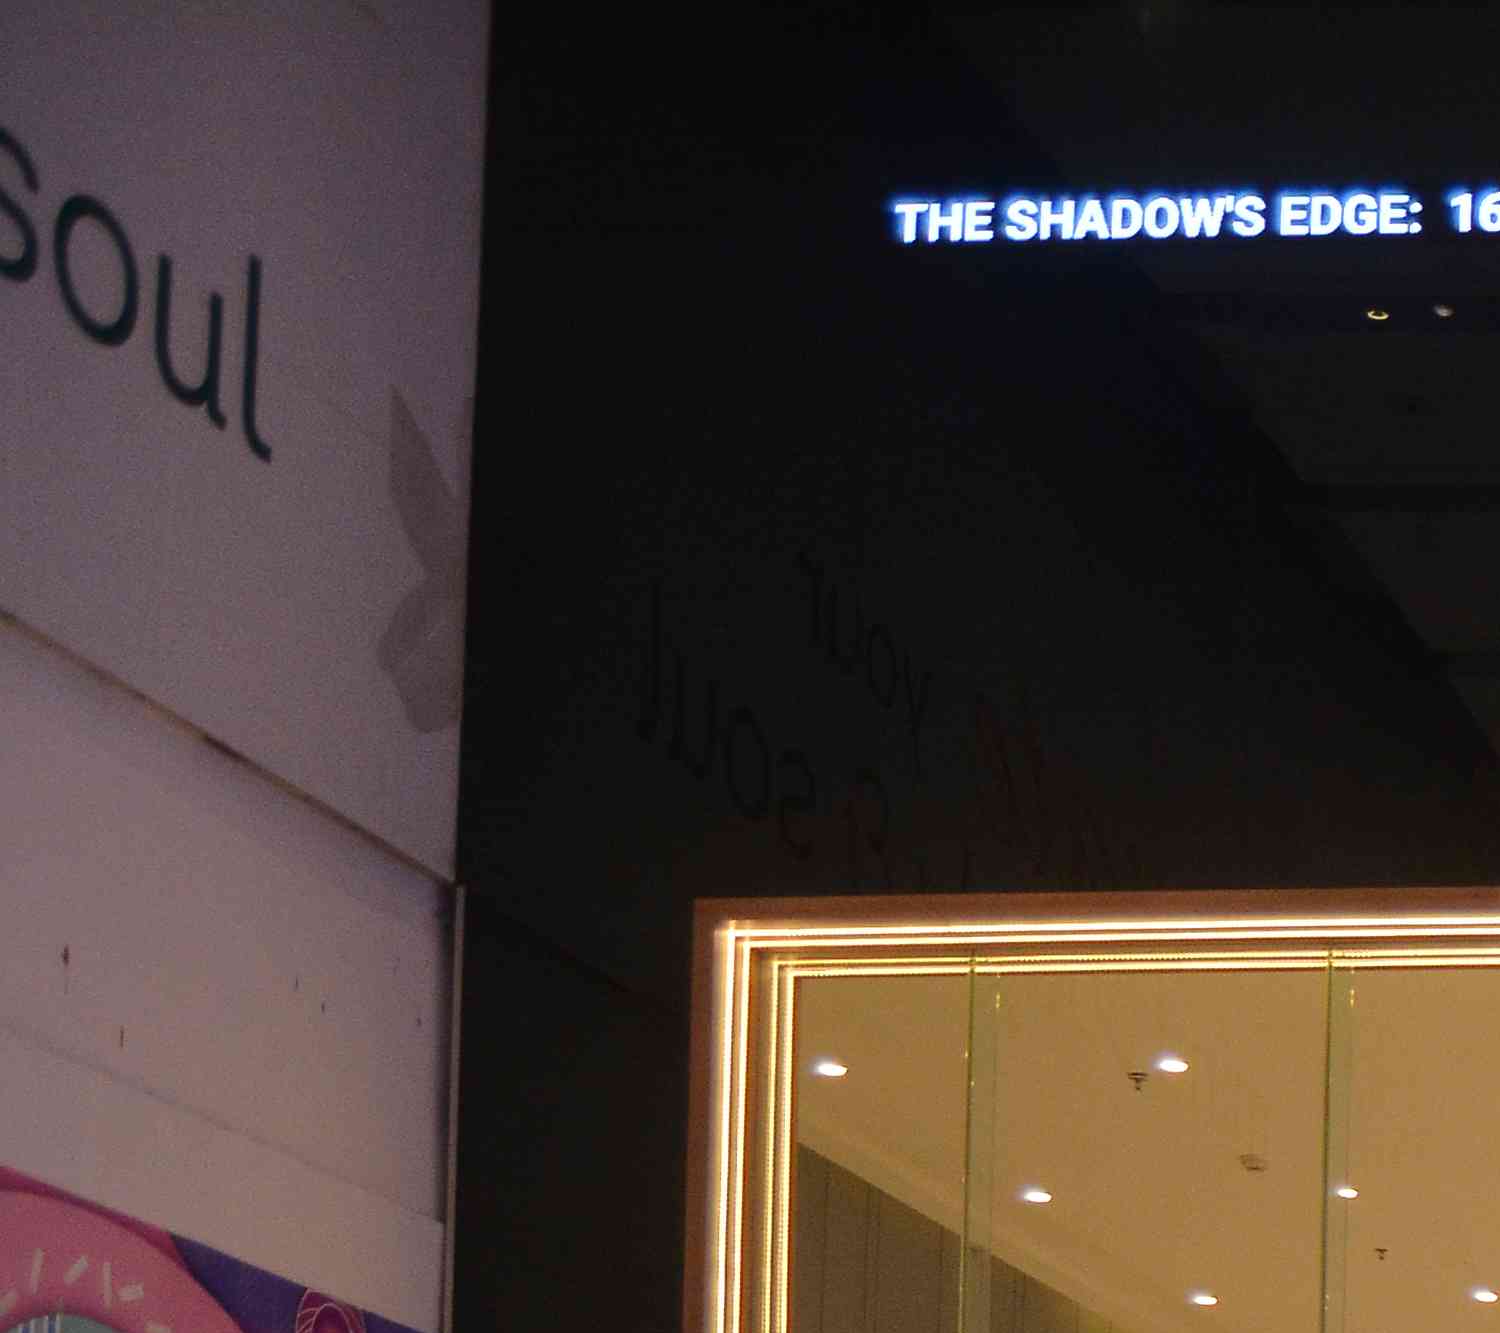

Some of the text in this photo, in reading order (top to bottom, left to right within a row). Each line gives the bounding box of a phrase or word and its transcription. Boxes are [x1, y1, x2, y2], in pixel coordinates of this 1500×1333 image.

[894, 200, 995, 244] THE
[1005, 195, 1266, 242] SHADOW'S
[1279, 191, 1423, 237] EDGE:
